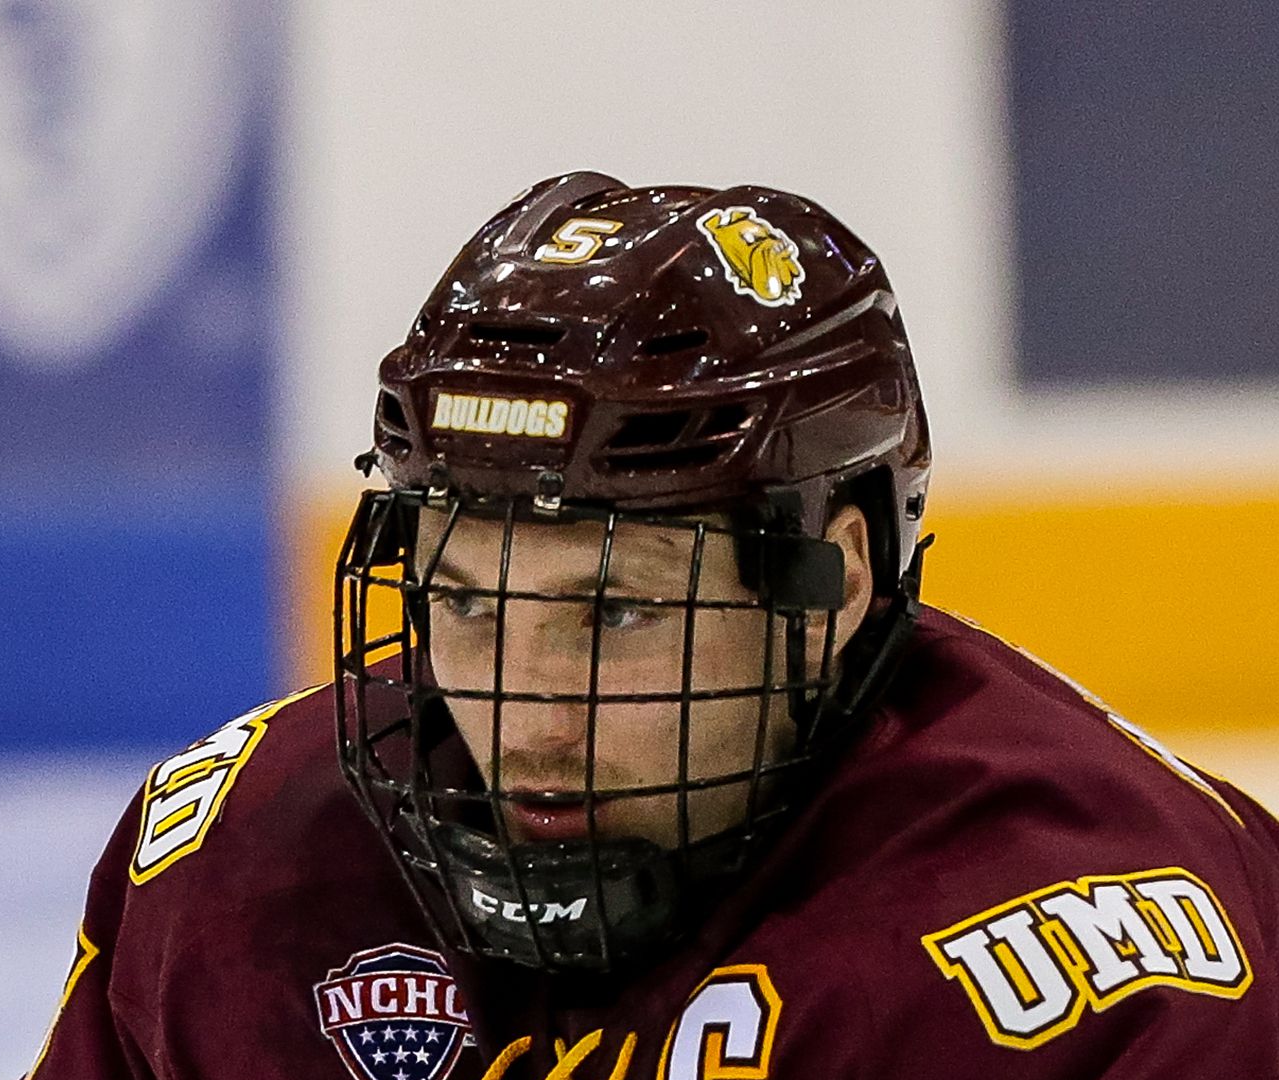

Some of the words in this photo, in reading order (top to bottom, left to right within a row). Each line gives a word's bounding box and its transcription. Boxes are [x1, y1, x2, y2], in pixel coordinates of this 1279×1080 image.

[534, 218, 624, 264] 5
[432, 393, 569, 438] BULLDOGS
[129, 700, 276, 886] MD
[472, 887, 588, 924] CCM
[921, 866, 1254, 1051] UMD
